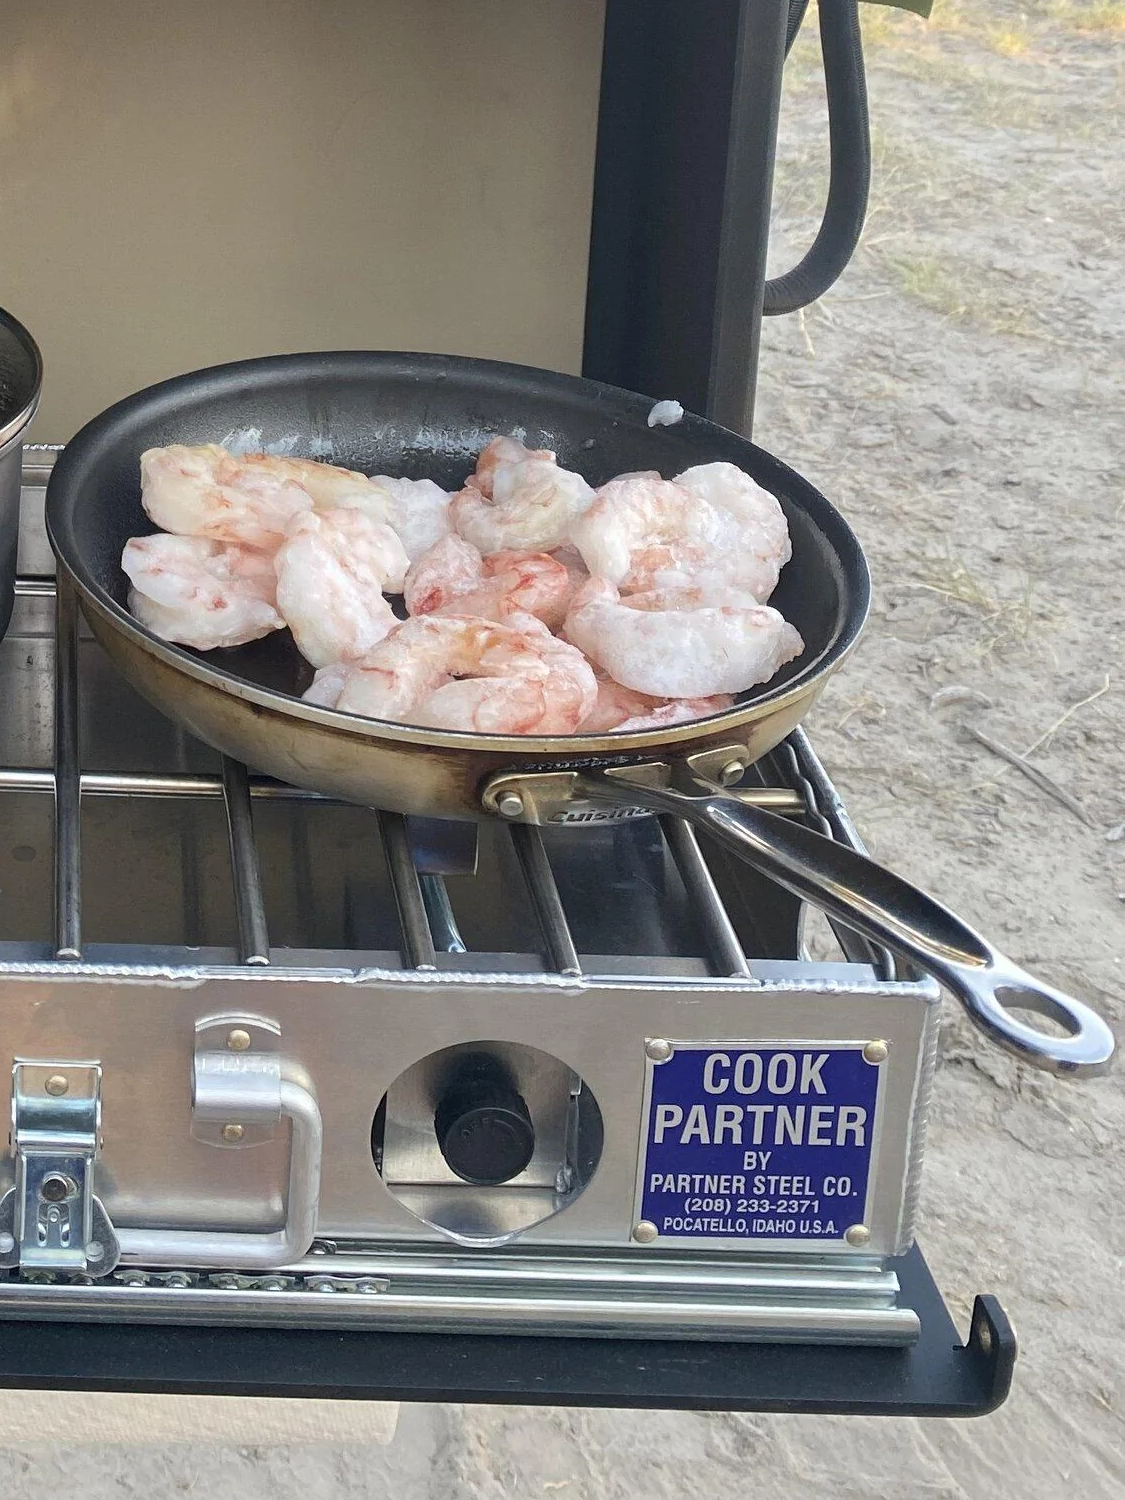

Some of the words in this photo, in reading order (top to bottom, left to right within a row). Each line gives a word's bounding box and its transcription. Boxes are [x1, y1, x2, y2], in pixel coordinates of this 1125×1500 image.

[703, 1053, 830, 1095] COOK
[653, 1104, 867, 1147] PARTNER
[743, 1151, 772, 1171] BY
[650, 1174, 746, 1195] PARTNER
[753, 1176, 815, 1196] STEEL
[823, 1177, 858, 1197] CO.
[684, 1198, 731, 1215] (208)
[736, 1199, 819, 1214] 233-2371
[663, 1217, 749, 1235] POCATELLO,
[752, 1218, 795, 1234] IDAHO
[800, 1219, 839, 1234] U.S.A.
